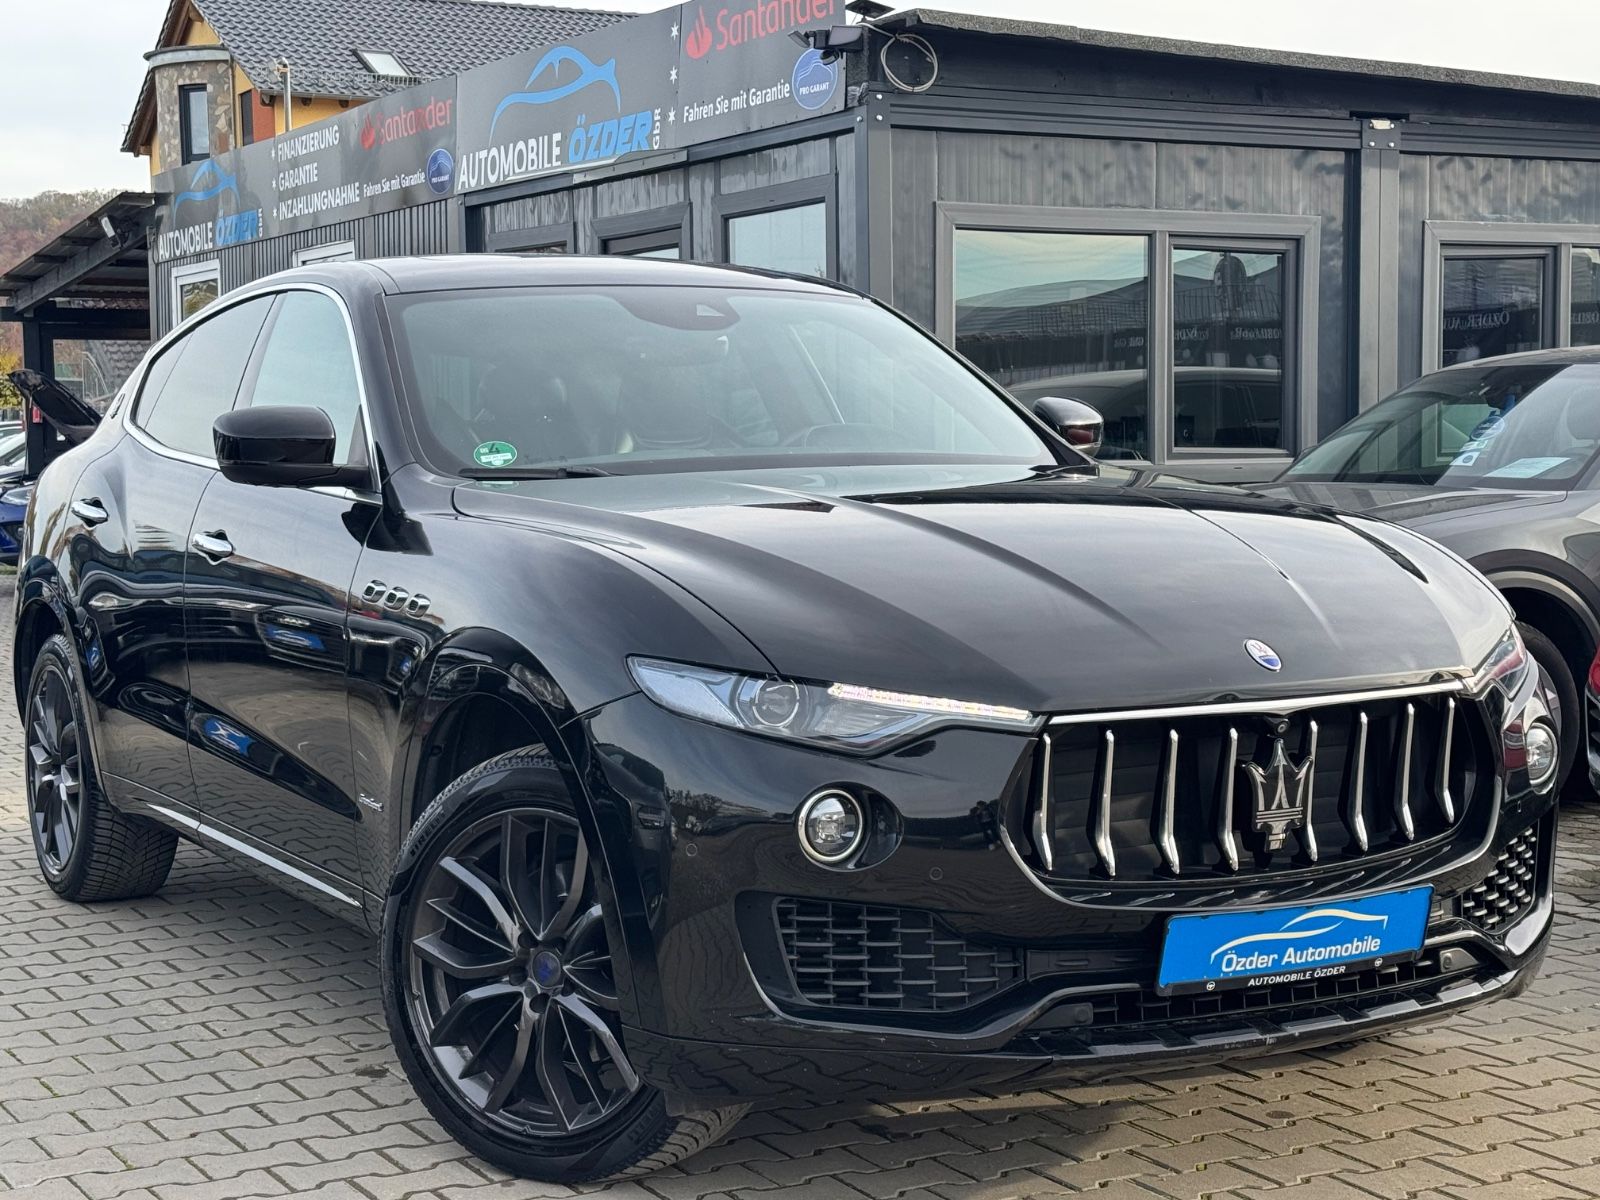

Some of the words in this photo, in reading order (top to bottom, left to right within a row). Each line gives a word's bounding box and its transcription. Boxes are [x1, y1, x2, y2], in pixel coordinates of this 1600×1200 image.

[683, 102, 714, 123] Fahren
[715, 95, 729, 115] Sie
[731, 91, 747, 111] mit
[749, 79, 790, 107] Garantie
[800, 86, 810, 95] PRO
[810, 82, 829, 94] GARANT
[376, 96, 452, 145] Santander
[278, 125, 339, 162] FINANZIERUNG
[458, 132, 562, 190] AUTOMOBILE
[569, 111, 652, 164] ÖZDER
[653, 108, 661, 150] GbR
[279, 162, 318, 191] GARANTIE
[363, 182, 381, 198] Fahren
[381, 178, 391, 193] Sie
[391, 174, 400, 190] mit
[401, 168, 426, 188] Garantie
[280, 182, 360, 220] INZAHLUNGNAHME
[159, 221, 213, 260] AUTOMOBILE
[215, 208, 257, 246] ÖZDER
[1221, 950, 1278, 973] Özder
[1281, 935, 1381, 965] Automobile
[1248, 971, 1312, 987] AUTOMOBILE
[1314, 965, 1346, 978] ÖZDER
